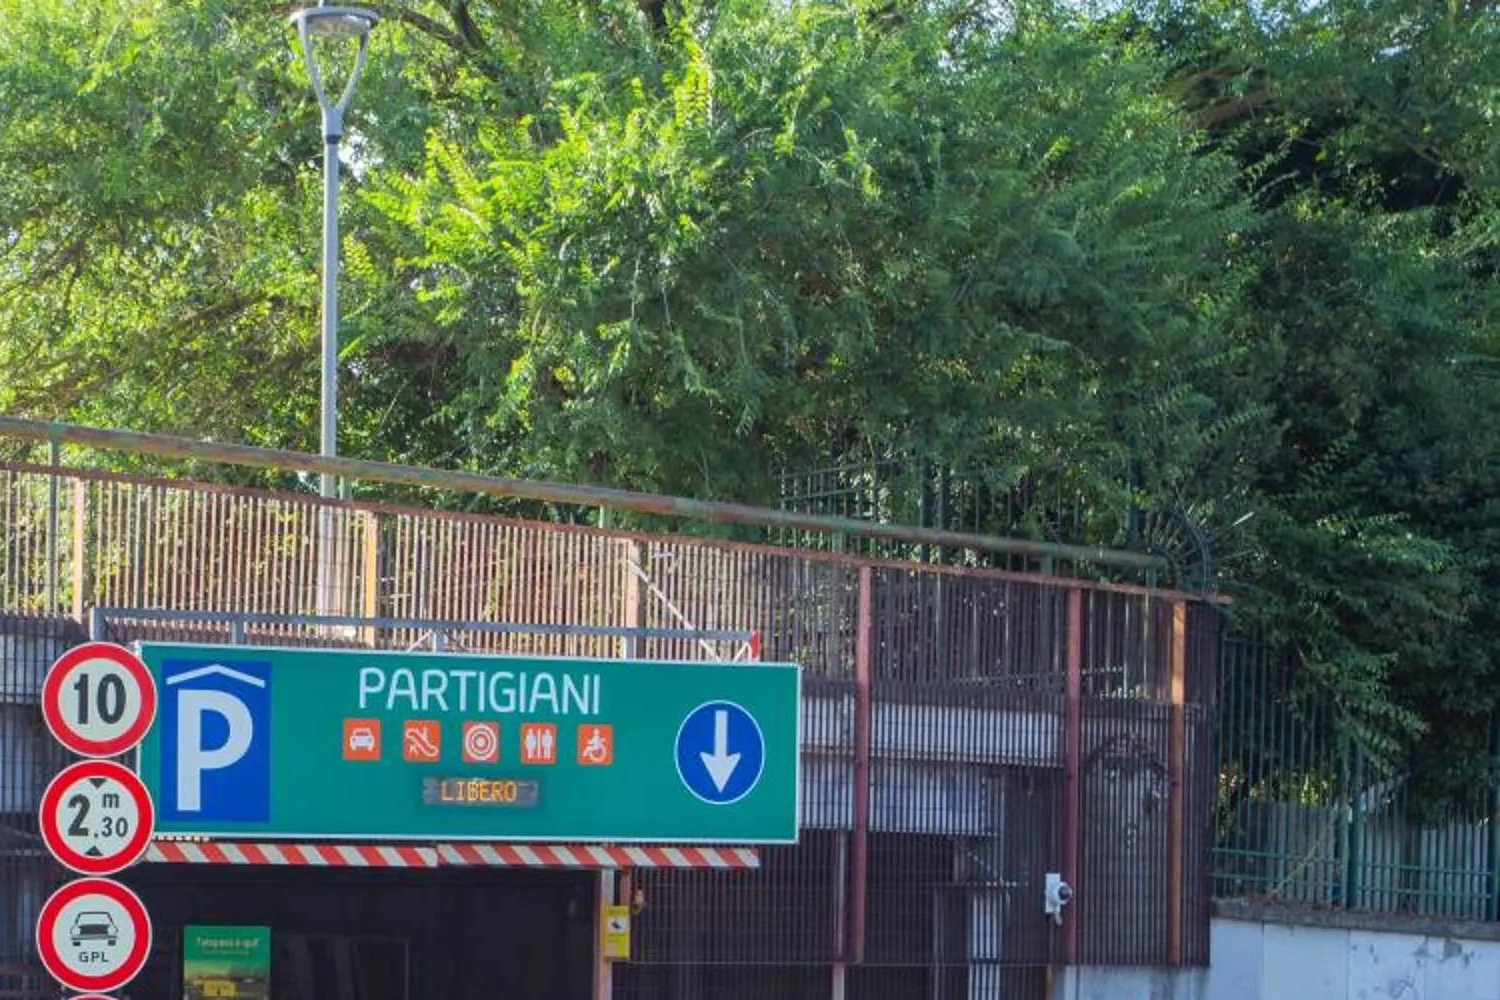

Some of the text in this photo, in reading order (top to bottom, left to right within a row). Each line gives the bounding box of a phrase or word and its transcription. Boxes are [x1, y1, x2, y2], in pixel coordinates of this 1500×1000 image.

[73, 673, 127, 724] 10
[358, 667, 601, 715] PARTIGIANI
[177, 688, 253, 812] P
[440, 778, 518, 803] LIBERO
[78, 951, 110, 963] GPL
